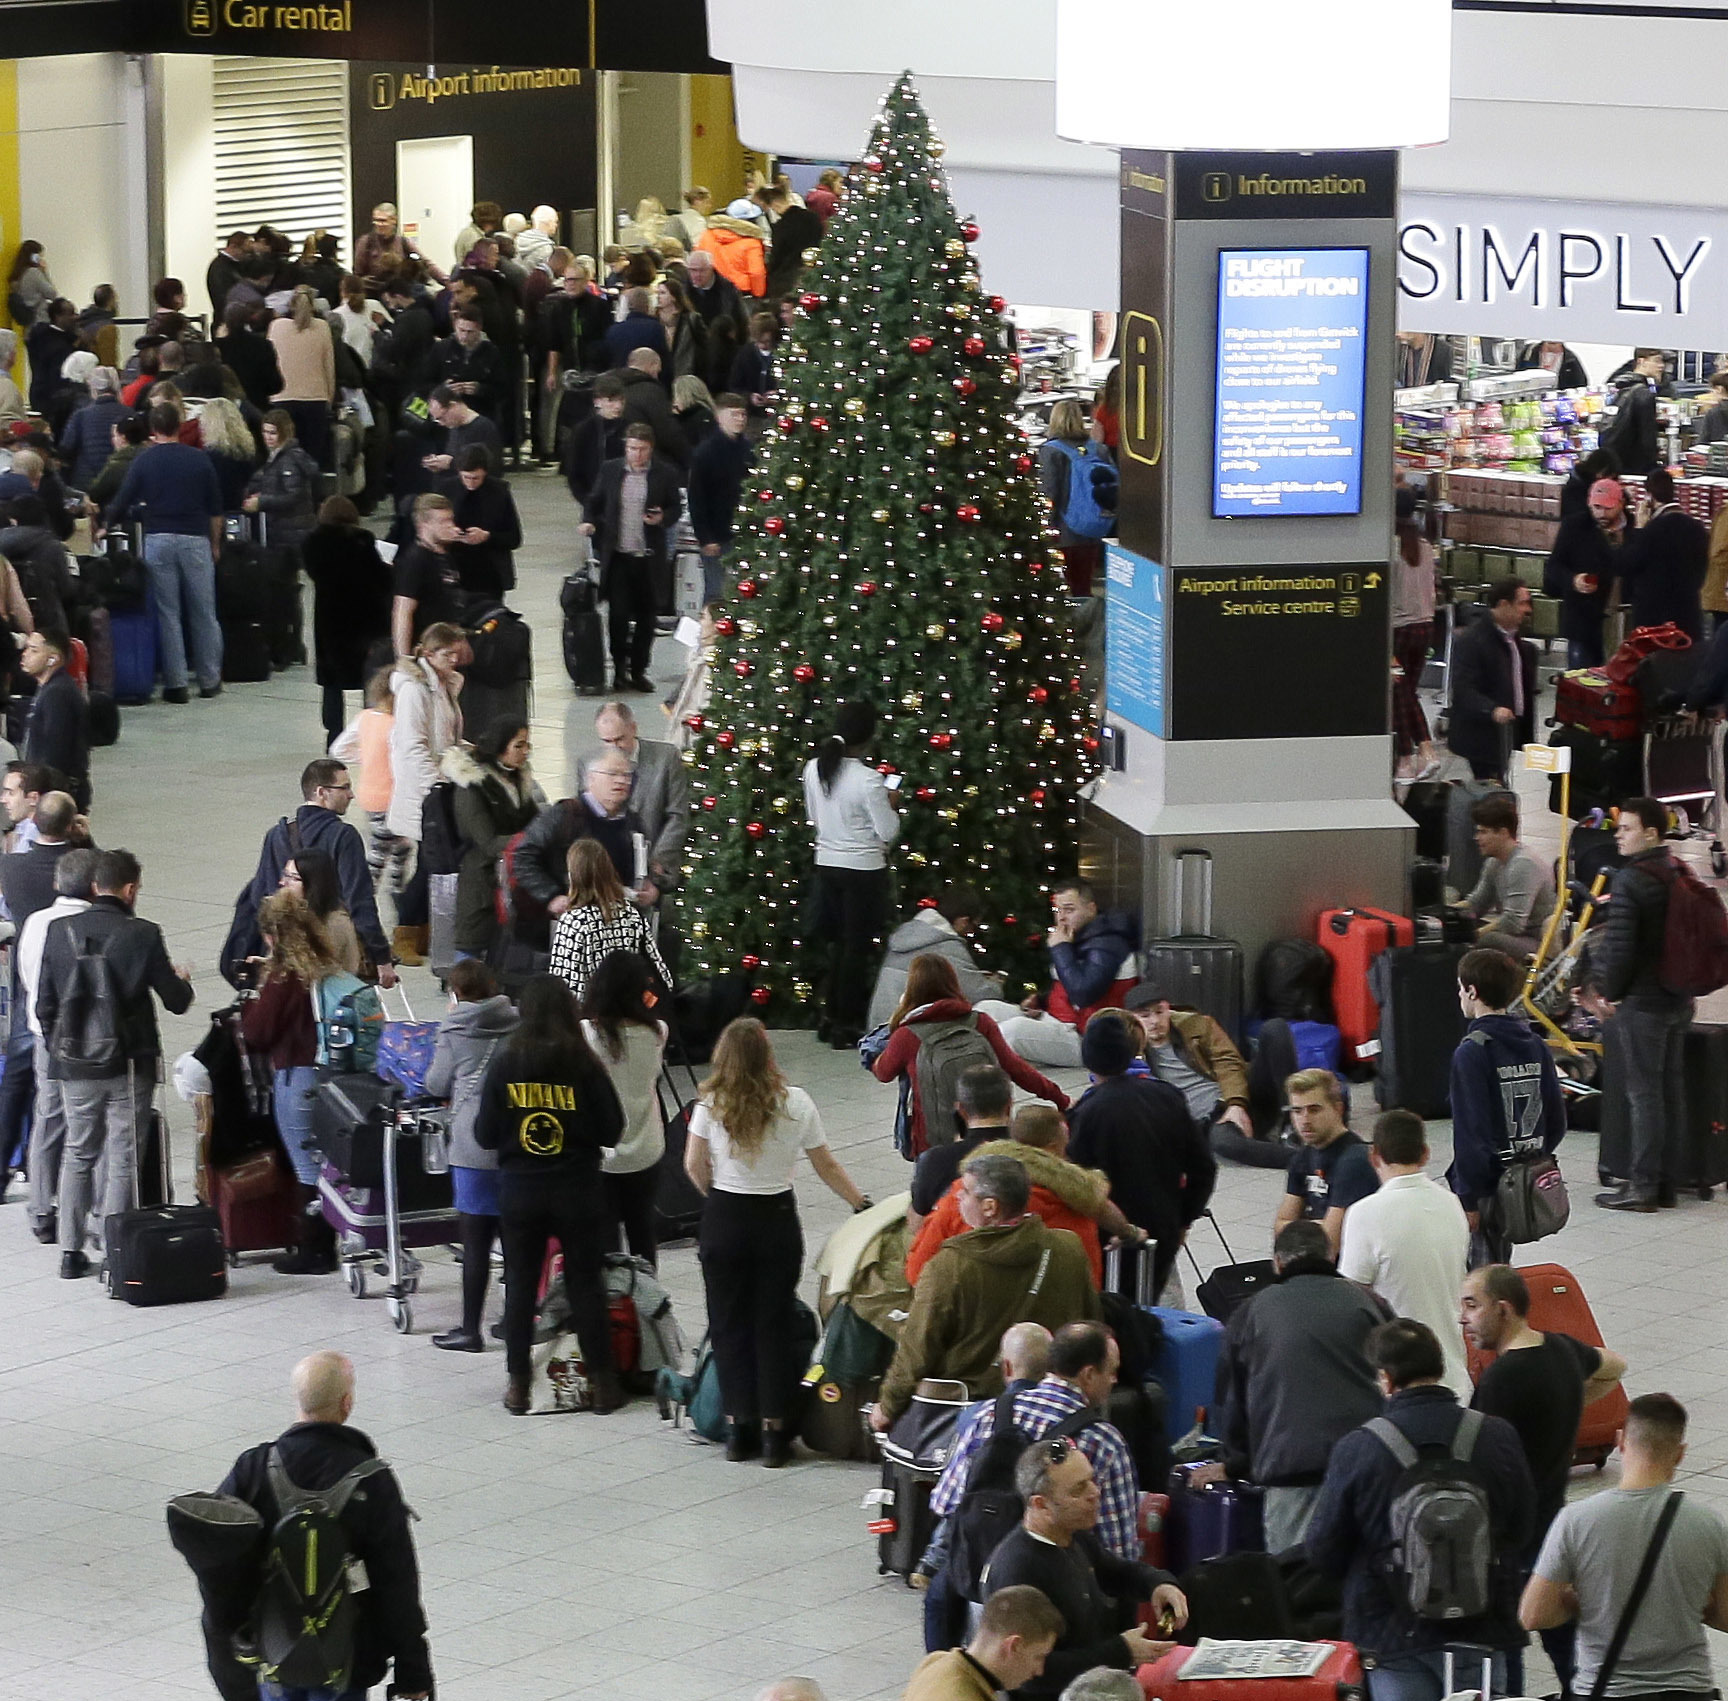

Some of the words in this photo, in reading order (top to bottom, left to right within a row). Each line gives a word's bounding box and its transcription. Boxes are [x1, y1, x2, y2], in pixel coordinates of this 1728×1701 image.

[224, 0, 269, 28] Car
[275, 0, 351, 31] rental
[399, 72, 470, 104] Airport
[472, 65, 580, 93] information
[1238, 173, 1366, 195] Information
[1226, 258, 1304, 277] FLIGHT
[1397, 223, 1708, 314] SIMPLY
[1225, 277, 1359, 297] DISRUPTION
[1178, 577, 1238, 597] Airport
[1240, 574, 1336, 591] information
[1221, 600, 1281, 616] Service
[1282, 601, 1336, 615] centre
[1499, 1078, 1543, 1139] 17
